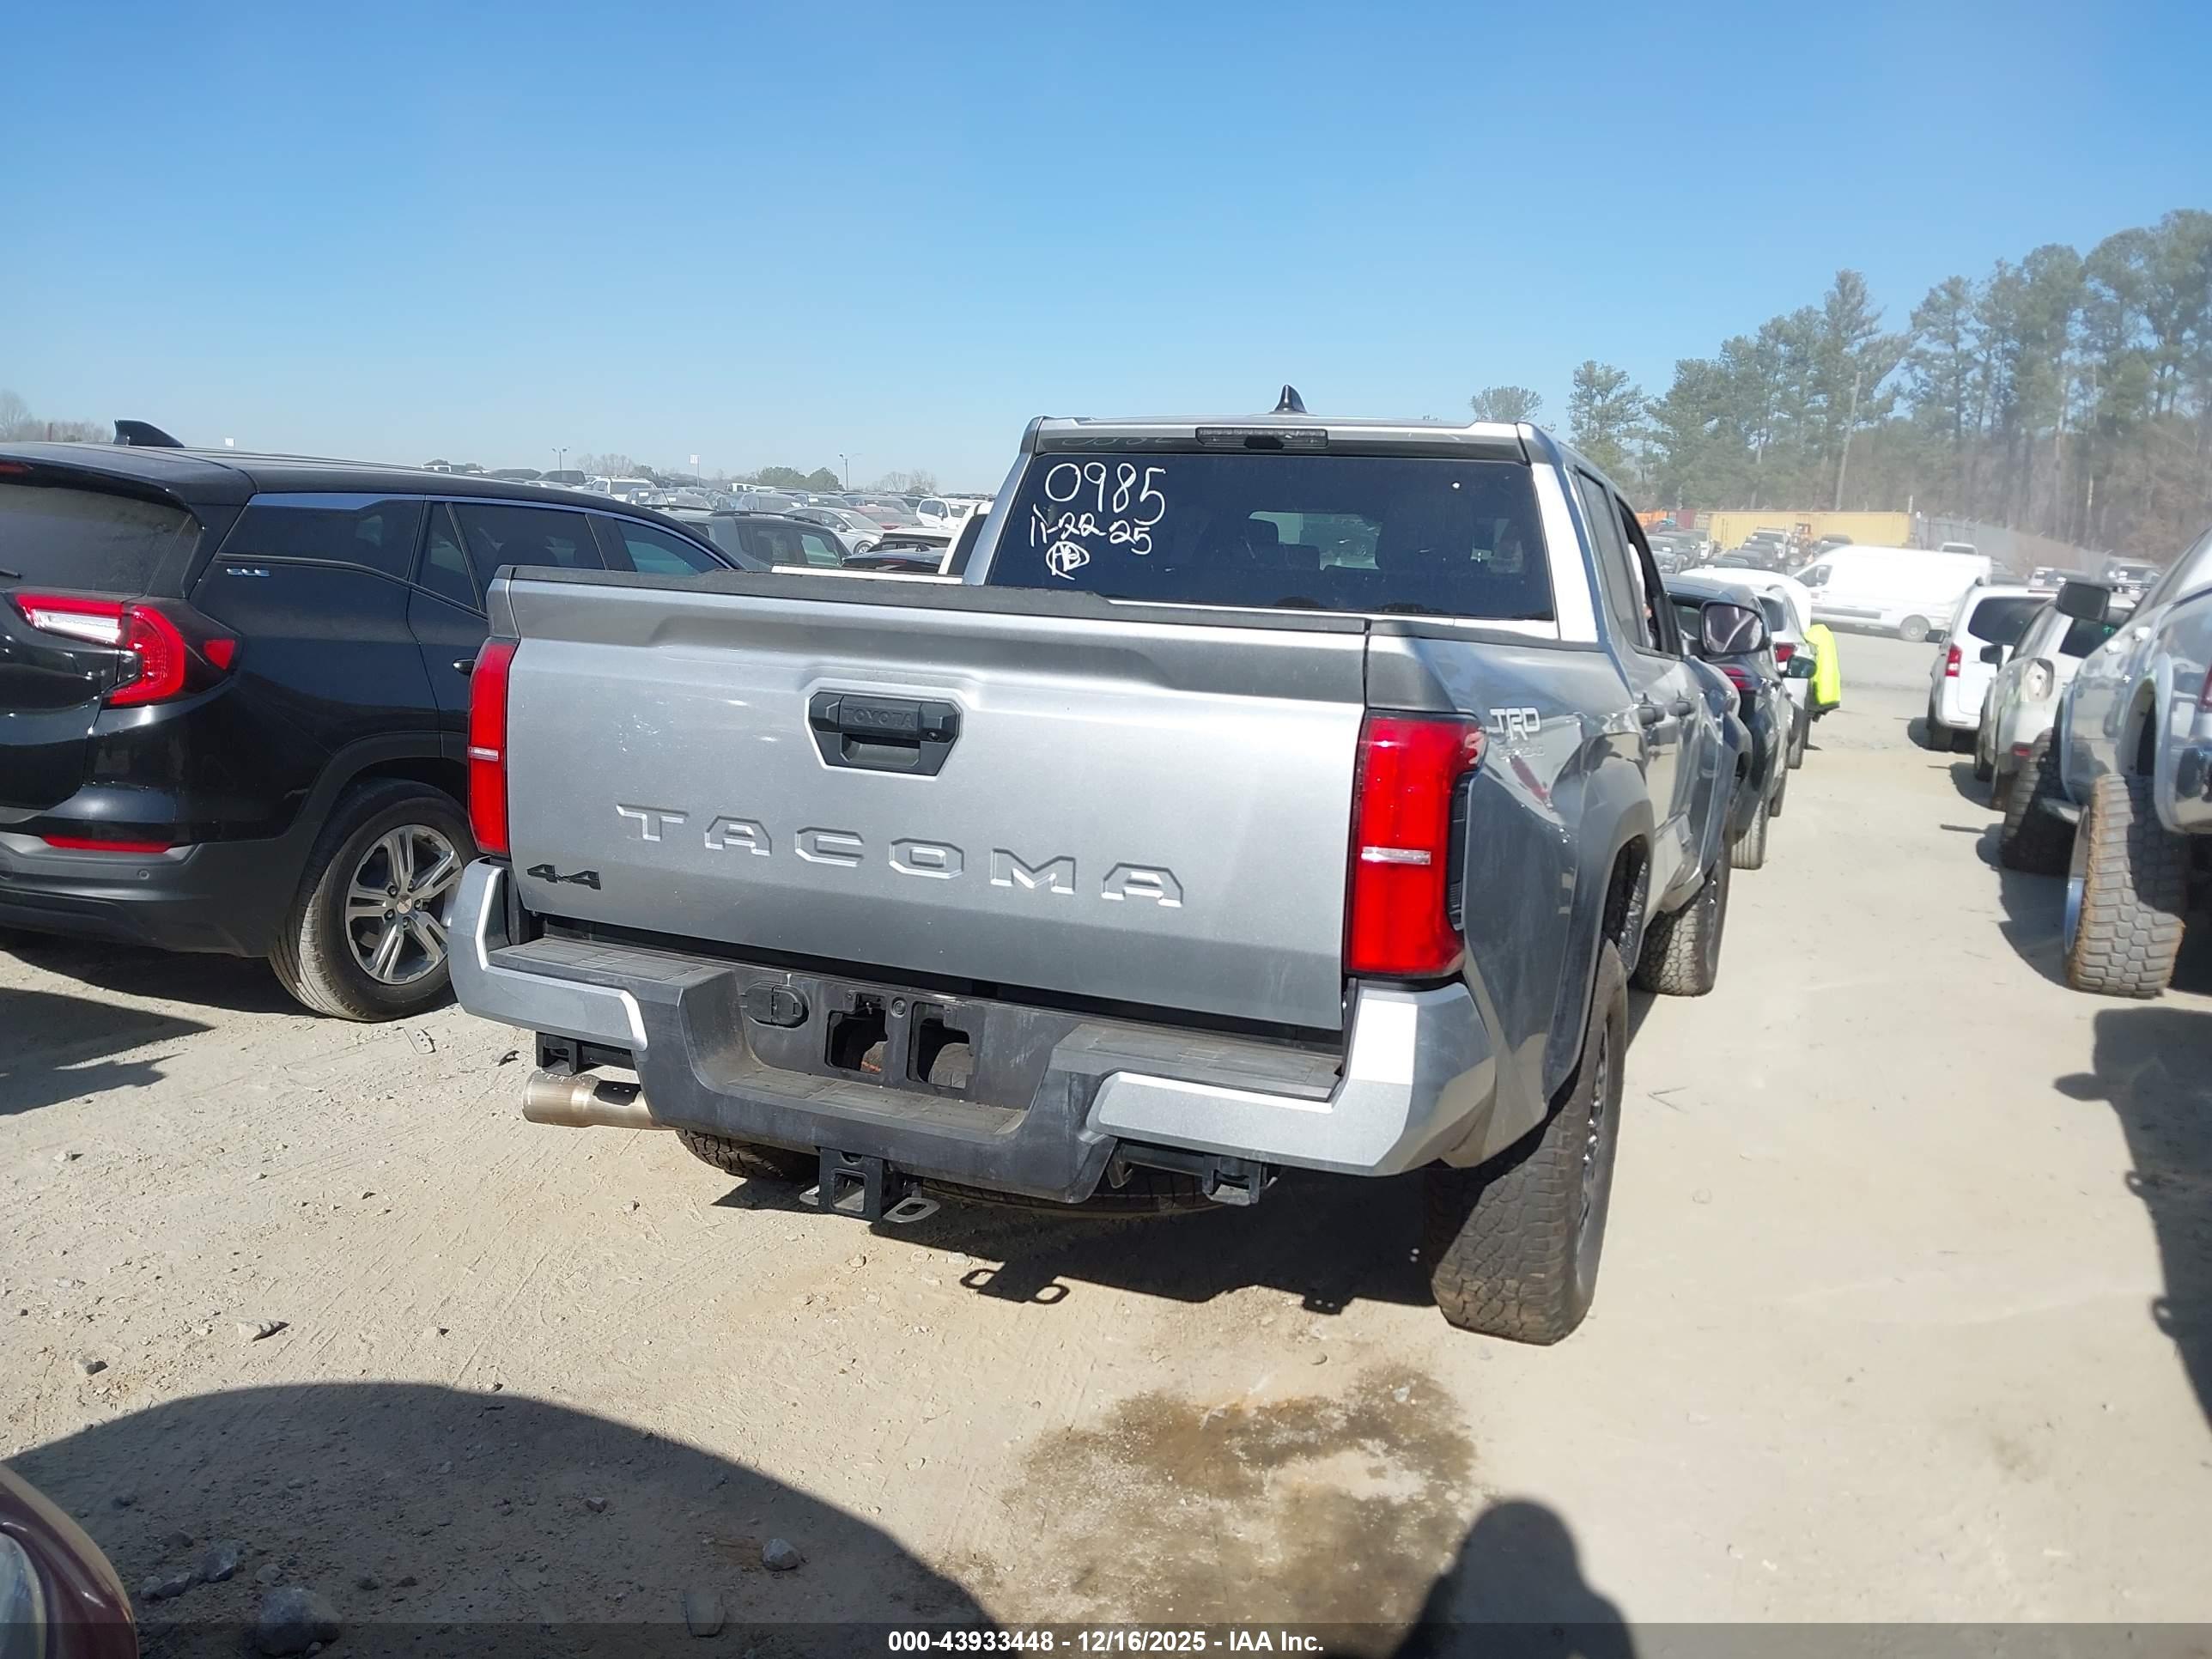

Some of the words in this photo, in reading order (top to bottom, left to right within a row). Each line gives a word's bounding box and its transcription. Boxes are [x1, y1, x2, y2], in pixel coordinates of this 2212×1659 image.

[1045, 462, 1166, 526] 0985
[842, 708, 915, 729] TOYOTA
[1489, 707, 1540, 741] TRD
[616, 804, 1184, 908] TACOMA
